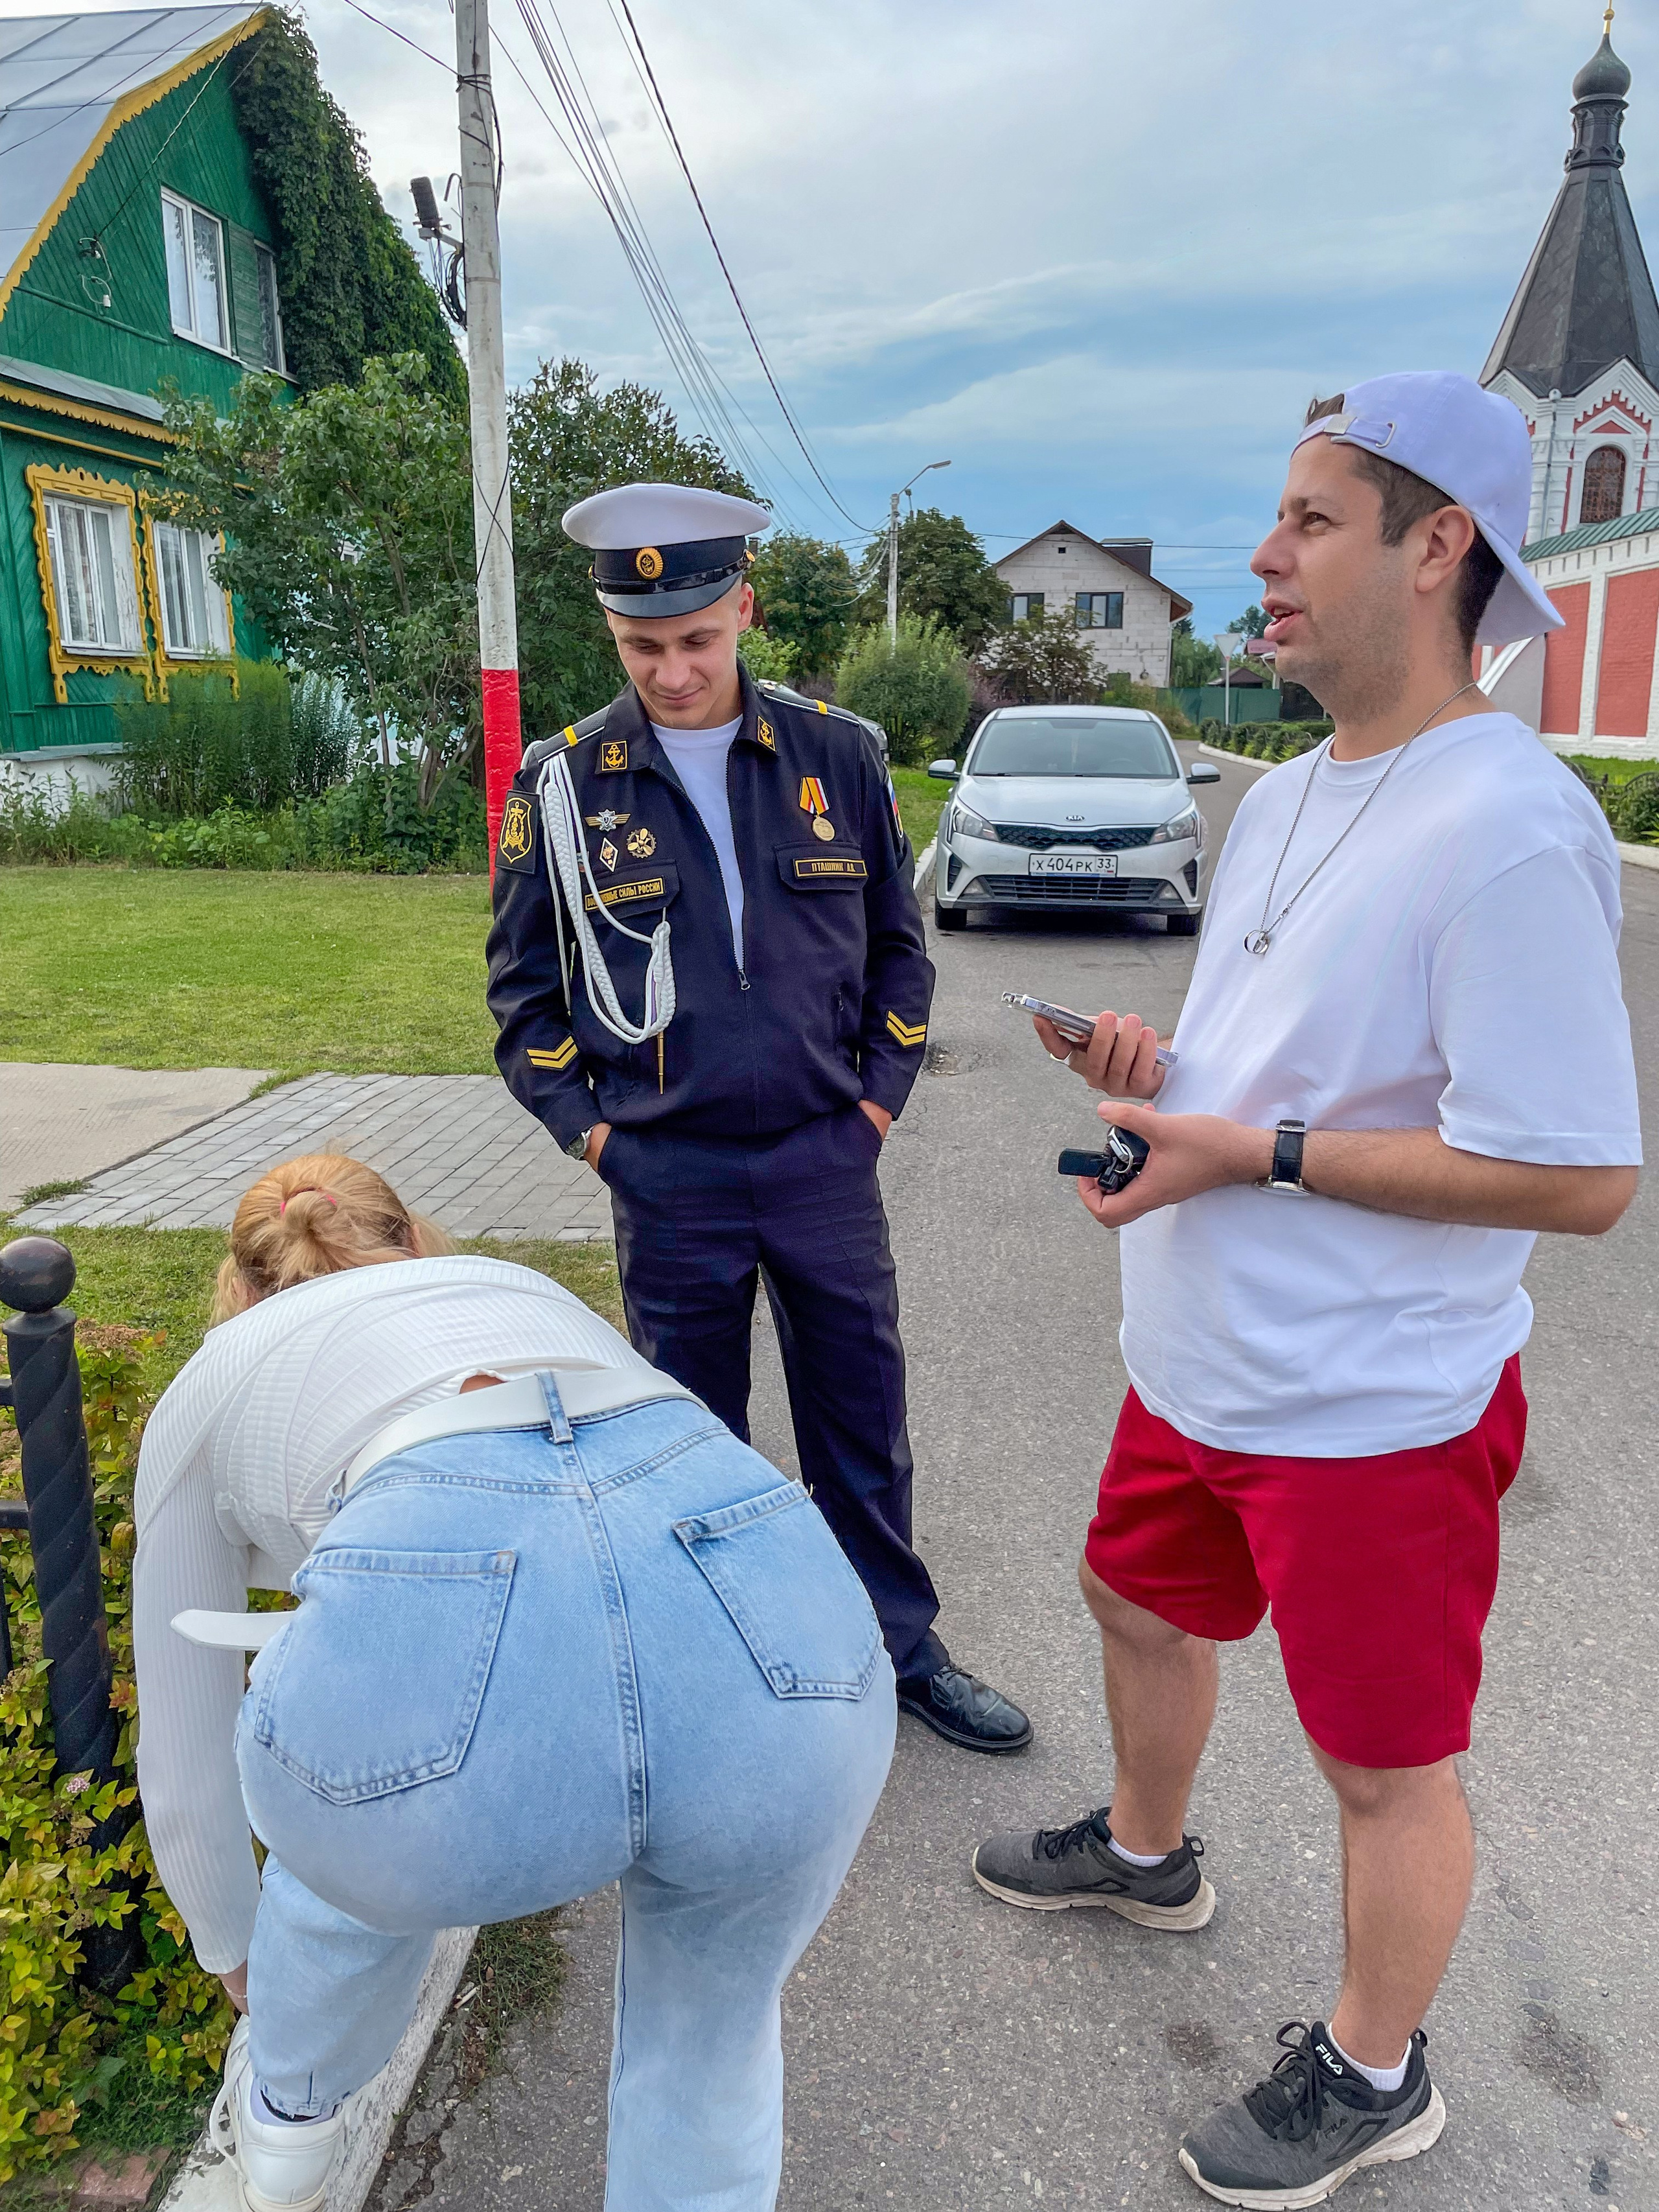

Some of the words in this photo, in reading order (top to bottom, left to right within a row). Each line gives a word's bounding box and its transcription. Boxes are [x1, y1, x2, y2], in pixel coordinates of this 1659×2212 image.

[1097, 859, 1111, 868] 33
[618, 885, 636, 898] СИЛЫ
[638, 881, 660, 894] РОССИИ
[1316, 2043, 1343, 2075] FILA
[1323, 2117, 1348, 2139] FILA
